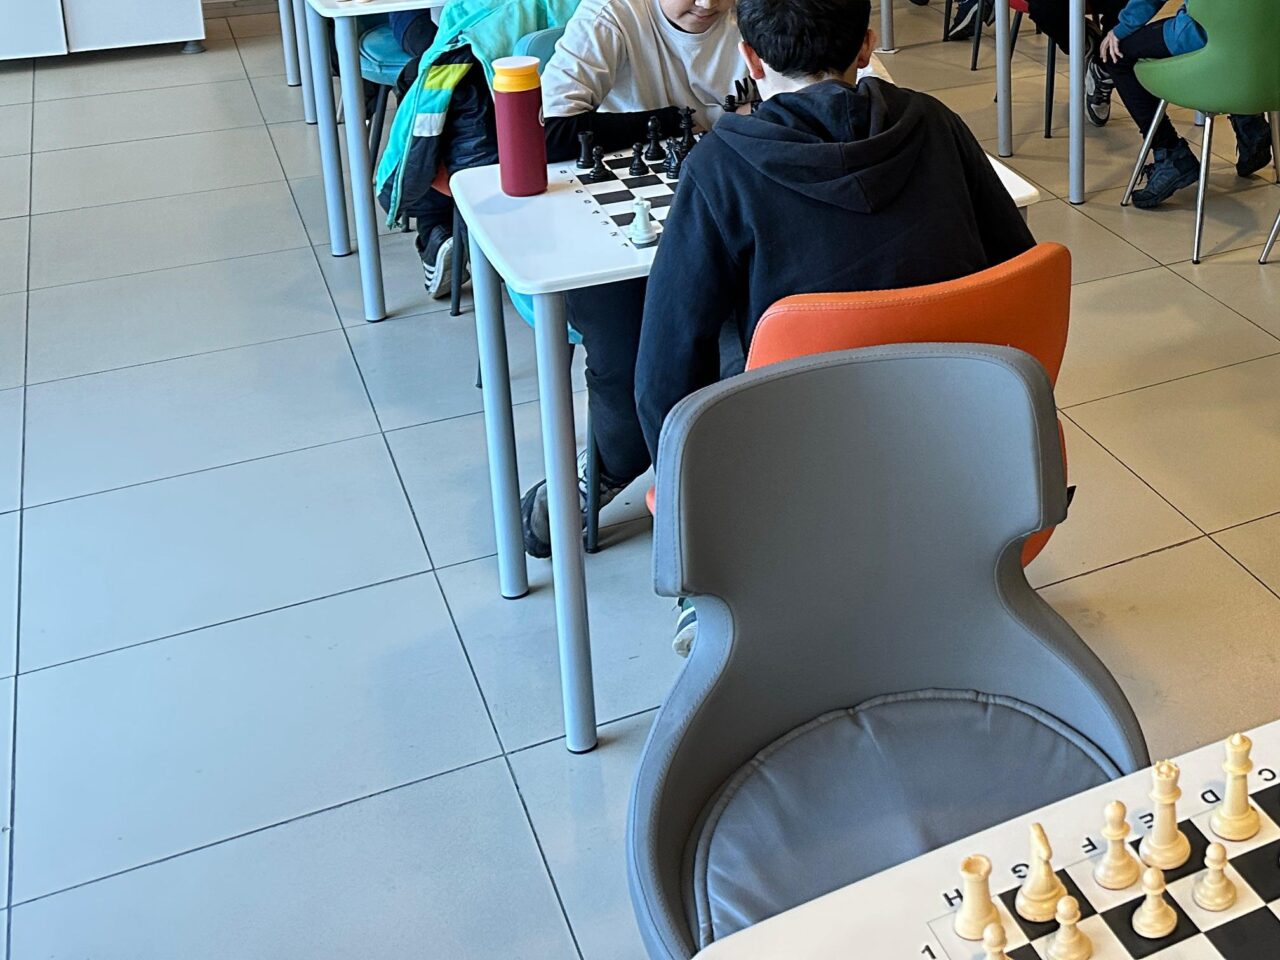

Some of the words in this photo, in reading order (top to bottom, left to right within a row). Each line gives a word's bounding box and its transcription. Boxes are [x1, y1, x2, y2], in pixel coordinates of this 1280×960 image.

[1258, 768, 1276, 781] C
[1200, 789, 1220, 804] D
[1082, 837, 1098, 853] F
[1011, 863, 1030, 879] G
[921, 945, 937, 959] 1
